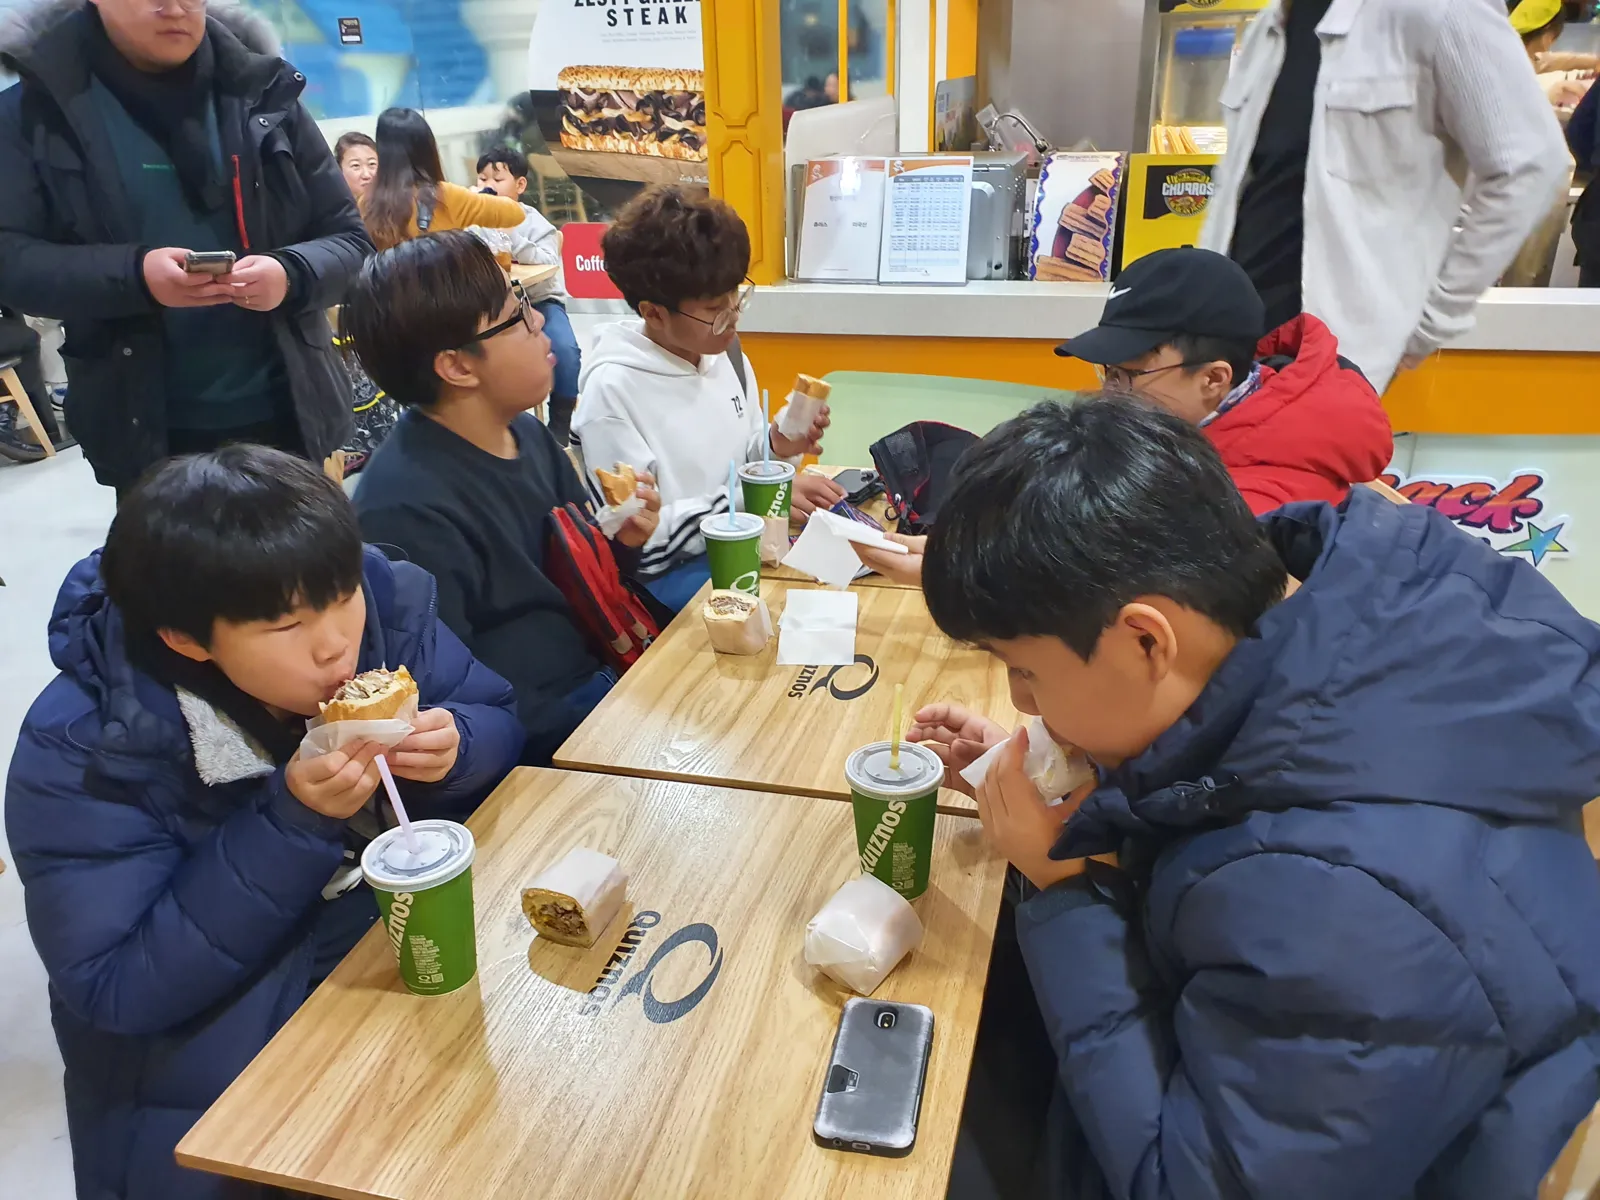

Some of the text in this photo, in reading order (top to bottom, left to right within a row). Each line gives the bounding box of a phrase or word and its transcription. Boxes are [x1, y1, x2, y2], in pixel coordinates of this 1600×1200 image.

[606, 6, 687, 27] STEAK
[731, 395, 743, 413] 72
[1380, 474, 1543, 533] ack
[787, 664, 819, 699] iznos
[388, 891, 414, 968] uiznos
